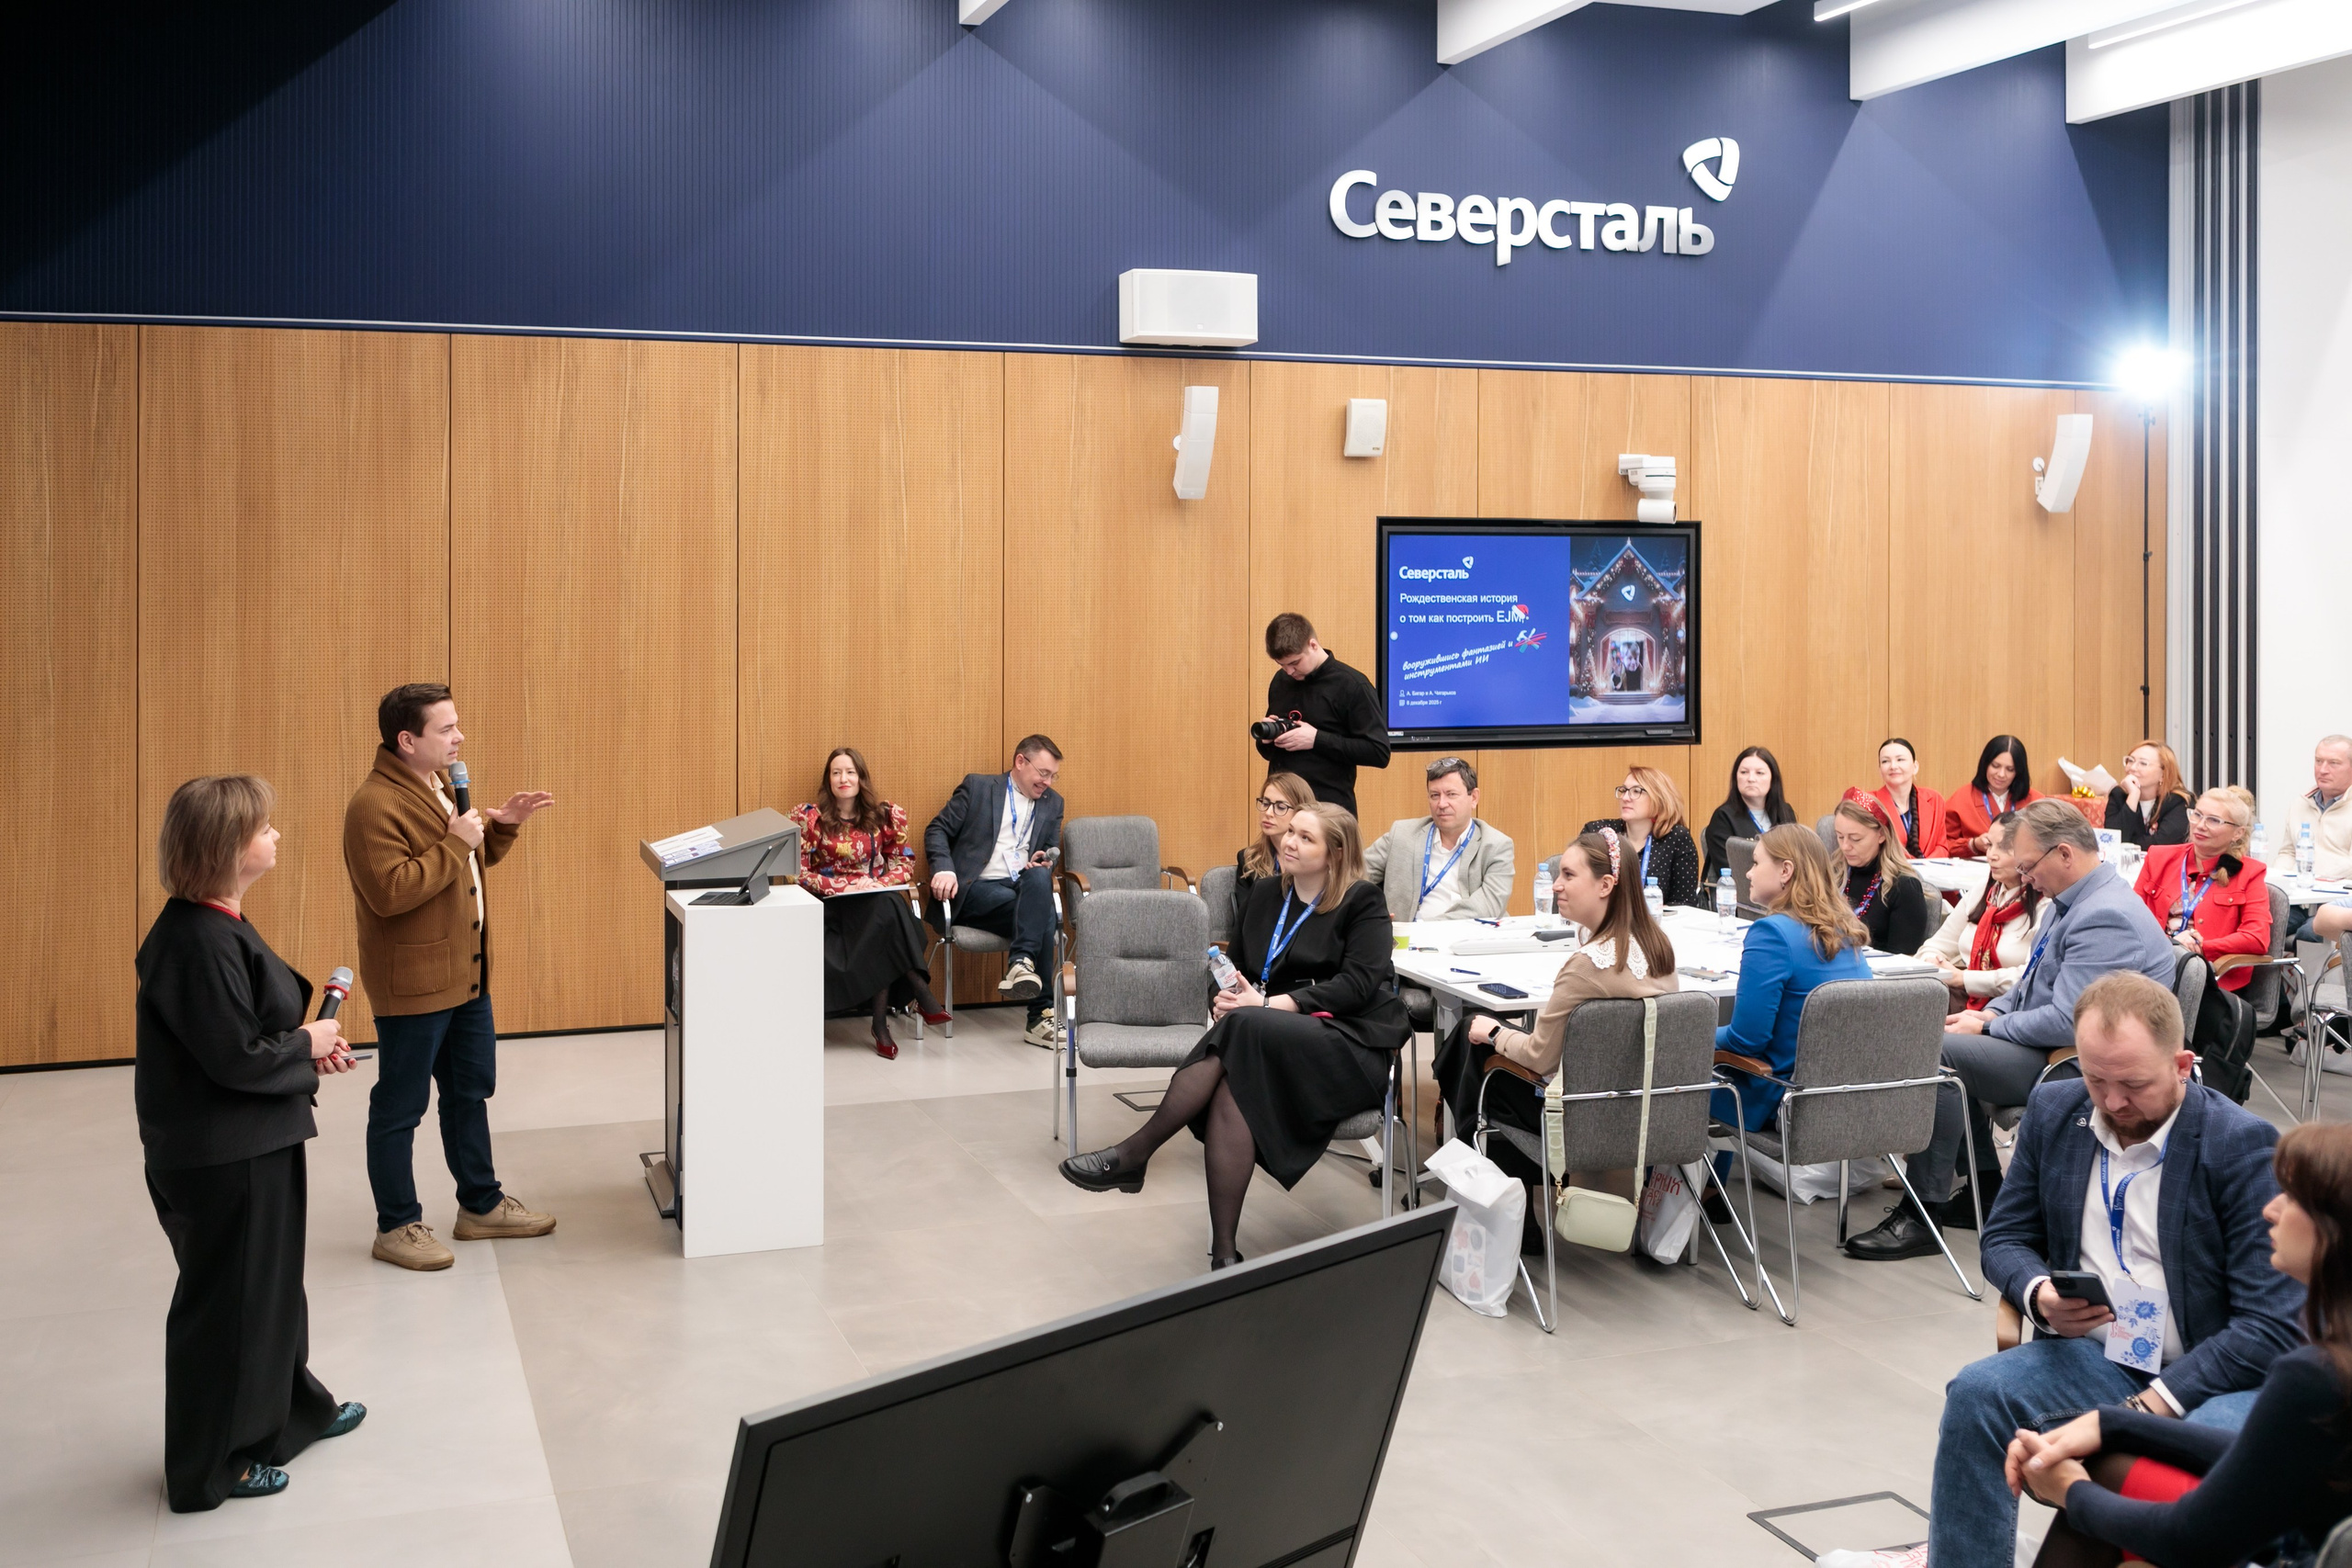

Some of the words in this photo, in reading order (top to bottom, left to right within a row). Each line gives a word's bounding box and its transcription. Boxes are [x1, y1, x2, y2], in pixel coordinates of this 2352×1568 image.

[1329, 169, 1715, 267] Северсталь
[1399, 566, 1470, 582] Северсталь
[1399, 592, 1478, 605] Рождественская
[1480, 594, 1519, 605] история
[1399, 615, 1407, 624] о
[1408, 615, 1426, 624] том
[1428, 615, 1444, 624] как
[1446, 615, 1495, 626] построить
[1402, 653, 1460, 671] вооружившись
[1461, 639, 1507, 660] фантазией
[1403, 659, 1474, 681] инструментами
[1475, 653, 1490, 665] ИИ
